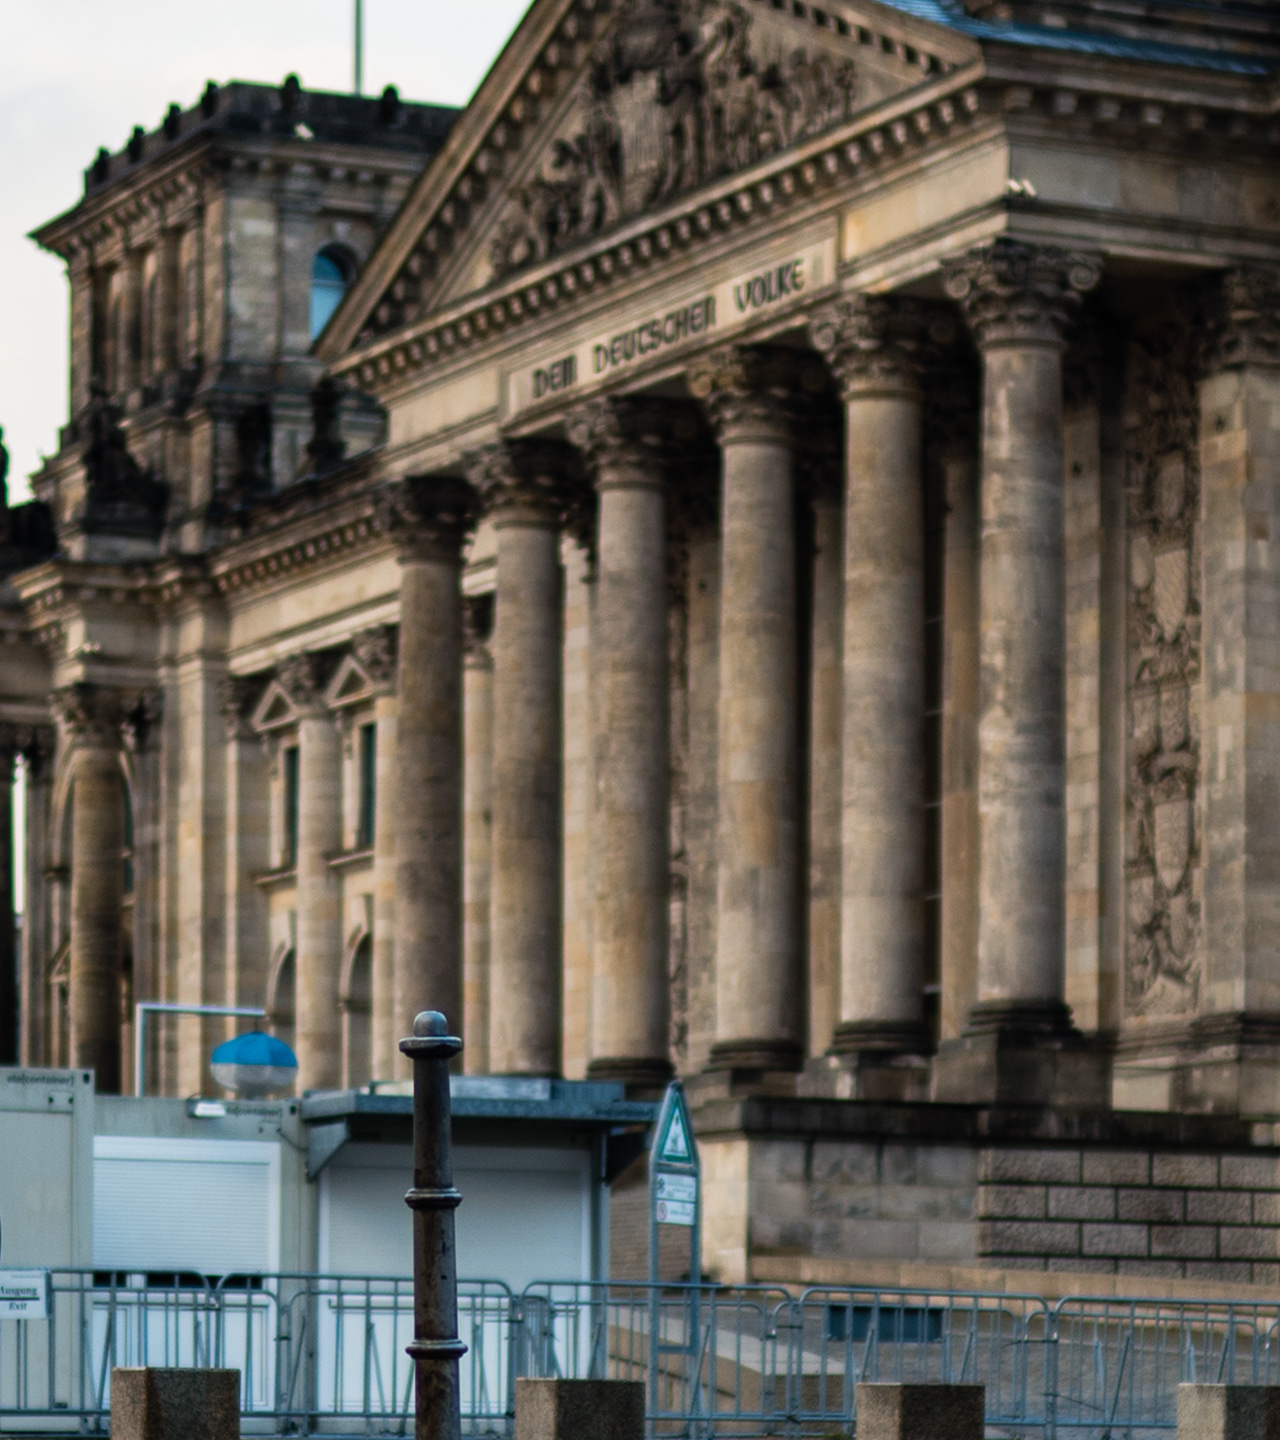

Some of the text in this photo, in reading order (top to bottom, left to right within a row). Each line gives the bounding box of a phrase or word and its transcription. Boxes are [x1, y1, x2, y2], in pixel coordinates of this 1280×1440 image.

[532, 258, 805, 399] DEM DEUTSCHEN VOLKE
[9, 1302, 28, 1311] Exit
